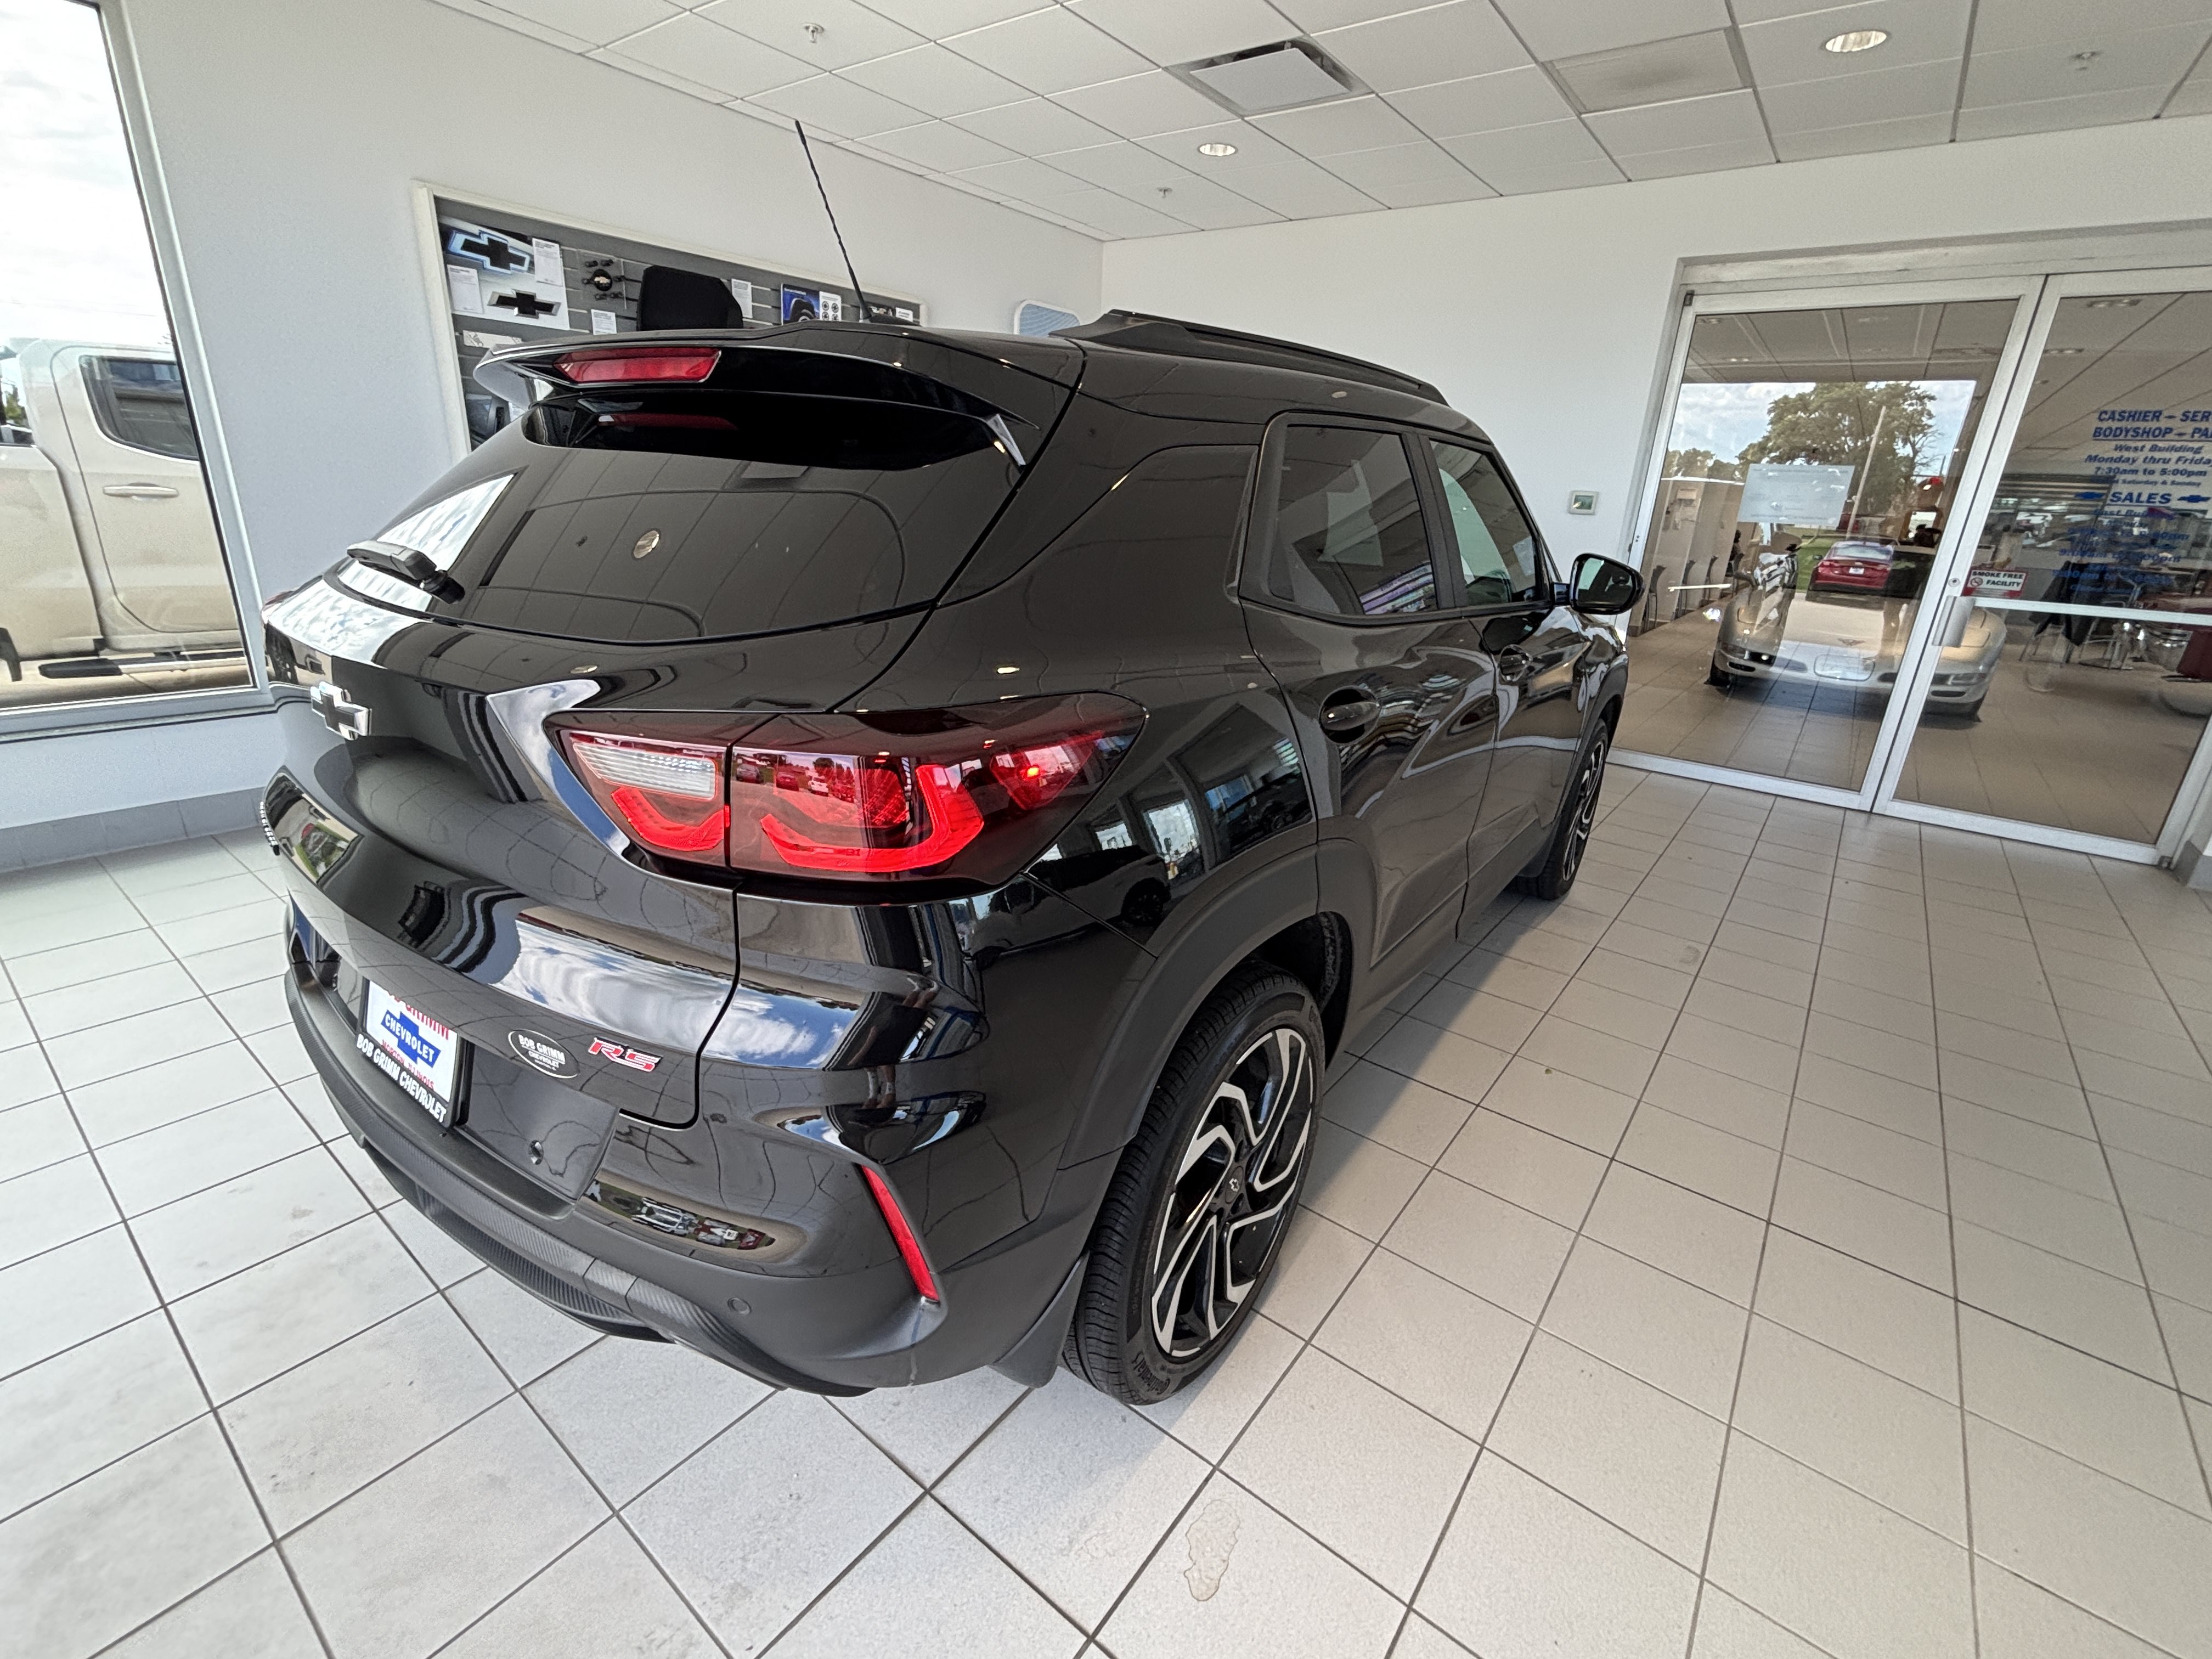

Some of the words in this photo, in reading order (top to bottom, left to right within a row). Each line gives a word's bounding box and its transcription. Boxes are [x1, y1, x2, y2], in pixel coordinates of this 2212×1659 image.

[2097, 410, 2163, 422] CASHIER
[2180, 410, 2212, 422] SER
[2092, 426, 2173, 438] BODYSHOP
[2114, 444, 2146, 452] West
[2148, 444, 2204, 454] Building
[2085, 454, 2138, 465] Monday
[2142, 455, 2171, 464] thru
[2095, 467, 2139, 476] 7:30am
[2142, 467, 2155, 476] to
[2160, 468, 2207, 478] 5:00pm
[2109, 492, 2172, 504] SALES
[385, 1014, 435, 1063] CHEVROLET
[518, 1034, 535, 1049] BOB
[537, 1042, 566, 1063] GRIMM
[588, 1037, 662, 1072] RS
[357, 1034, 374, 1058] BOB
[373, 1048, 401, 1081] GRIMM
[399, 1071, 447, 1122] CHEVROLET
